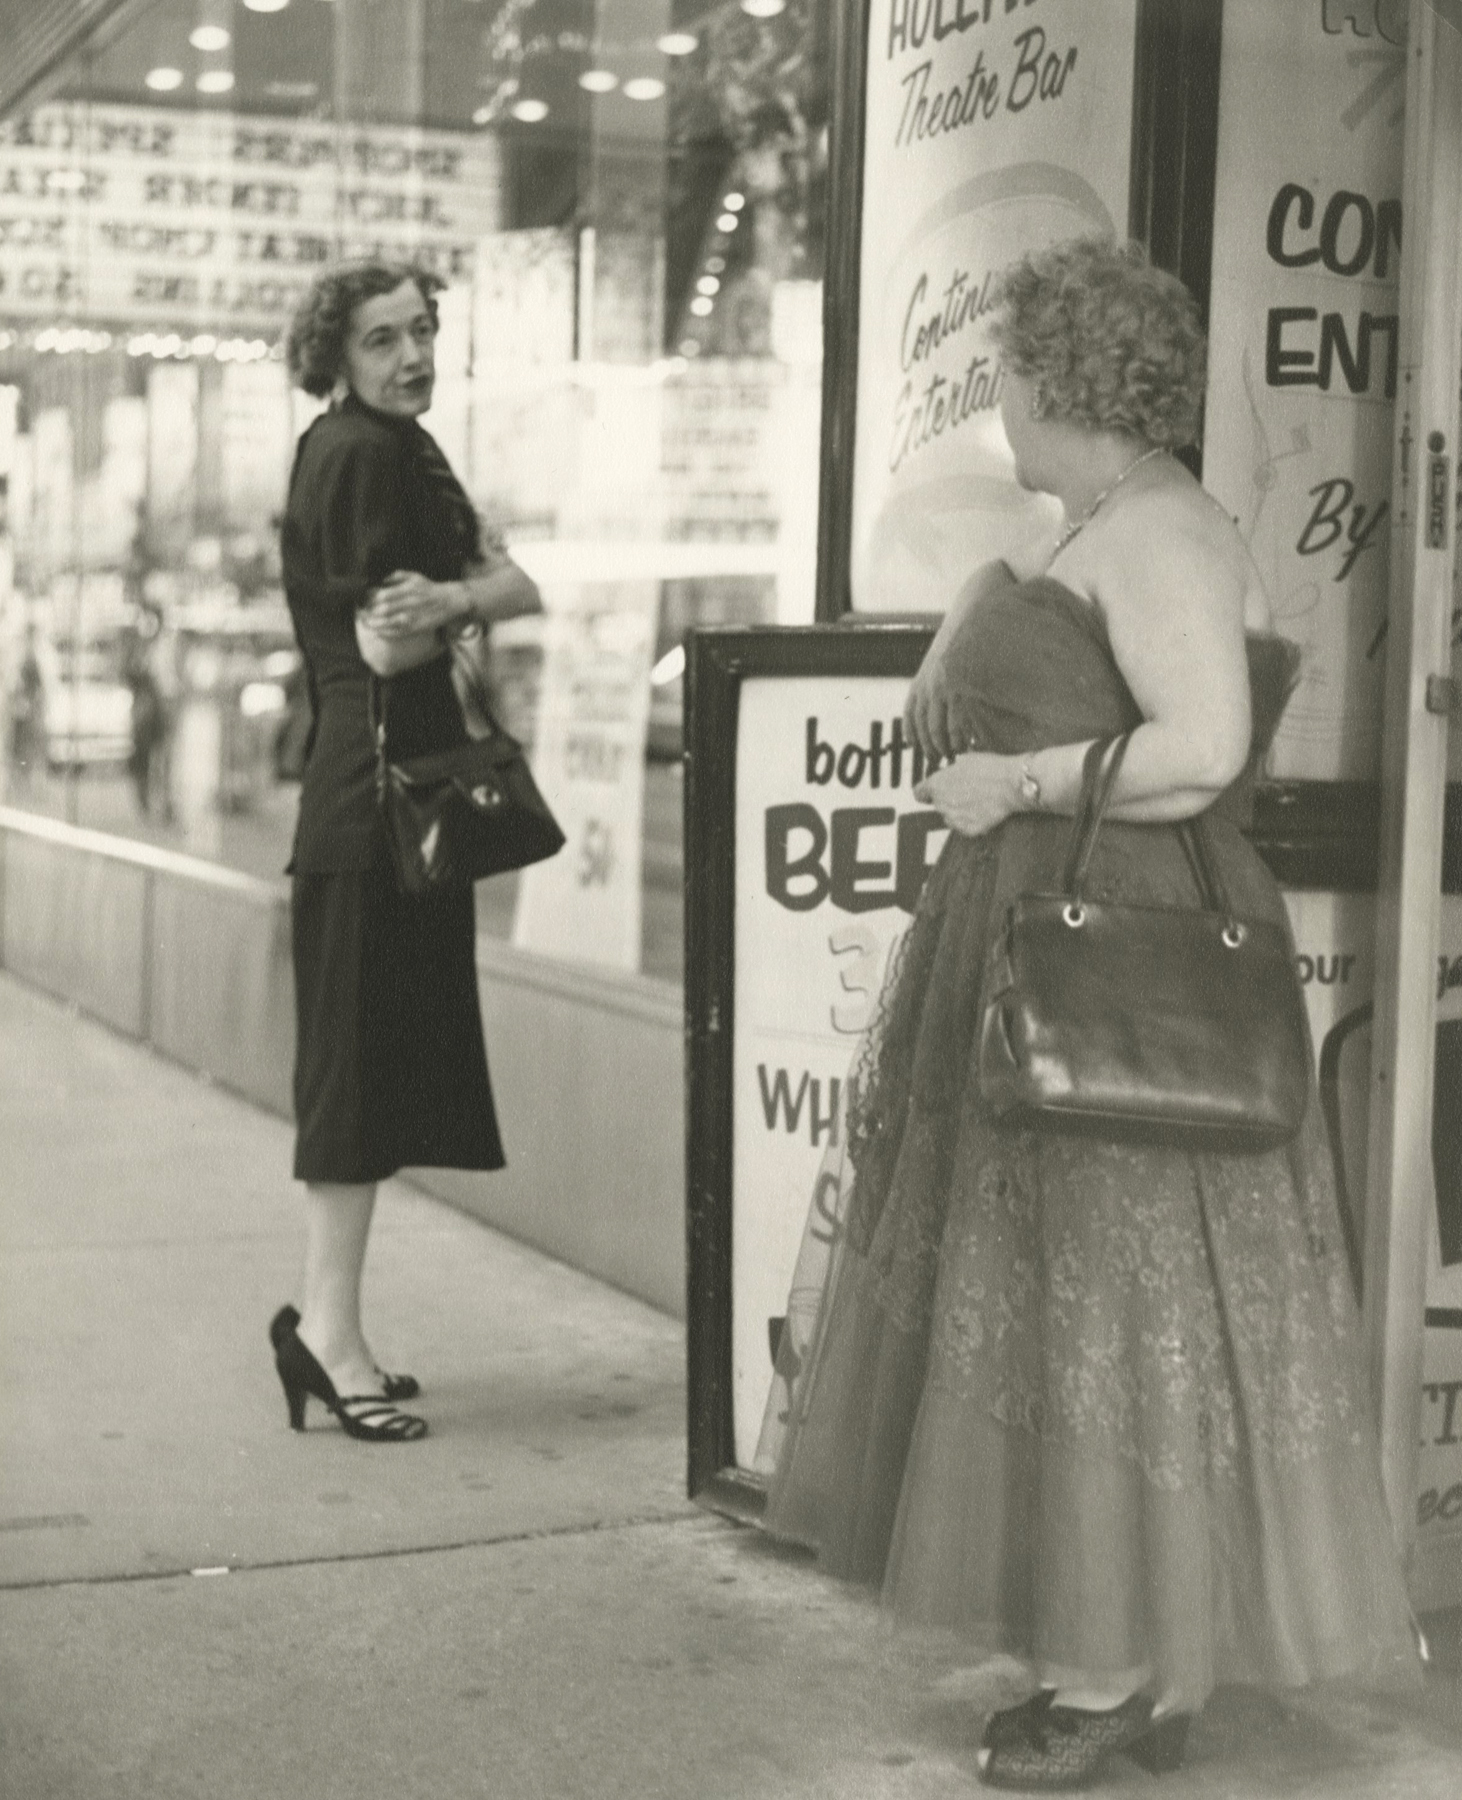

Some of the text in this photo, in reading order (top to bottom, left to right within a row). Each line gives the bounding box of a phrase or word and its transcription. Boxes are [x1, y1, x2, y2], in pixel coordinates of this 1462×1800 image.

[887, 0, 1038, 60] HOLL
[895, 26, 1078, 147] Theatre Bar
[1297, 477, 1391, 583] By
